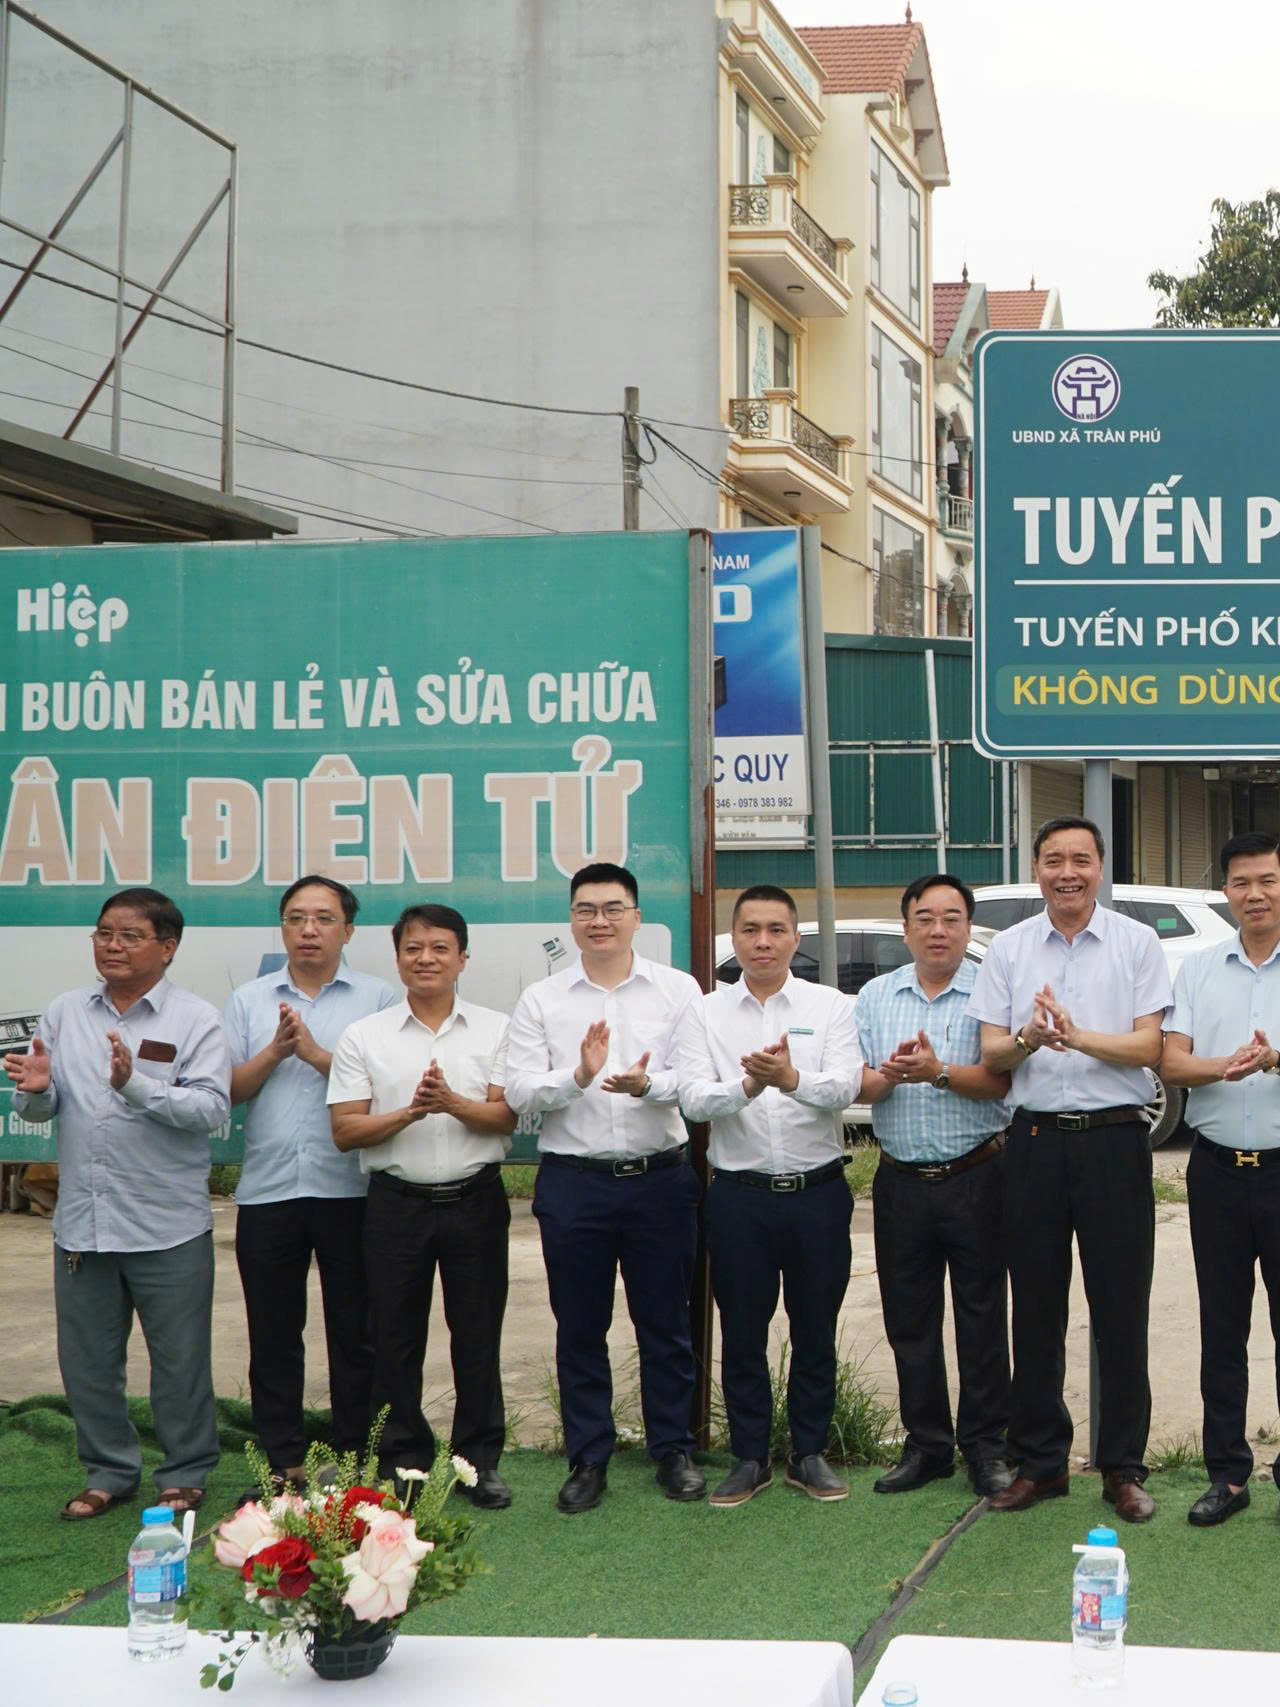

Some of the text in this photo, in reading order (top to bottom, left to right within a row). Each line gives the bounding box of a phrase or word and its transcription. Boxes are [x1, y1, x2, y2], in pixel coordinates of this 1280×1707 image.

[1013, 430, 1055, 443] UBND
[1060, 427, 1080, 443] XÃ
[1129, 427, 1161, 443] PHÚ
[1013, 475, 1223, 564] TUYẾN
[17, 581, 129, 648] Hiệp
[1014, 608, 1143, 647] TUYẾN
[1157, 607, 1240, 646] PHỐ
[22, 671, 145, 732] BUÔN
[161, 670, 257, 730] BÁN
[273, 663, 325, 730] LẺ
[340, 666, 401, 727] VÀ
[416, 657, 512, 725] SỬA
[528, 661, 657, 724] CHỮA
[1014, 669, 1157, 704] KHÔNG
[712, 753, 789, 784] C QUY
[0, 756, 152, 886] ÂN
[484, 735, 643, 881] TỬ
[738, 798, 759, 808] 0978
[760, 797, 776, 807] 383
